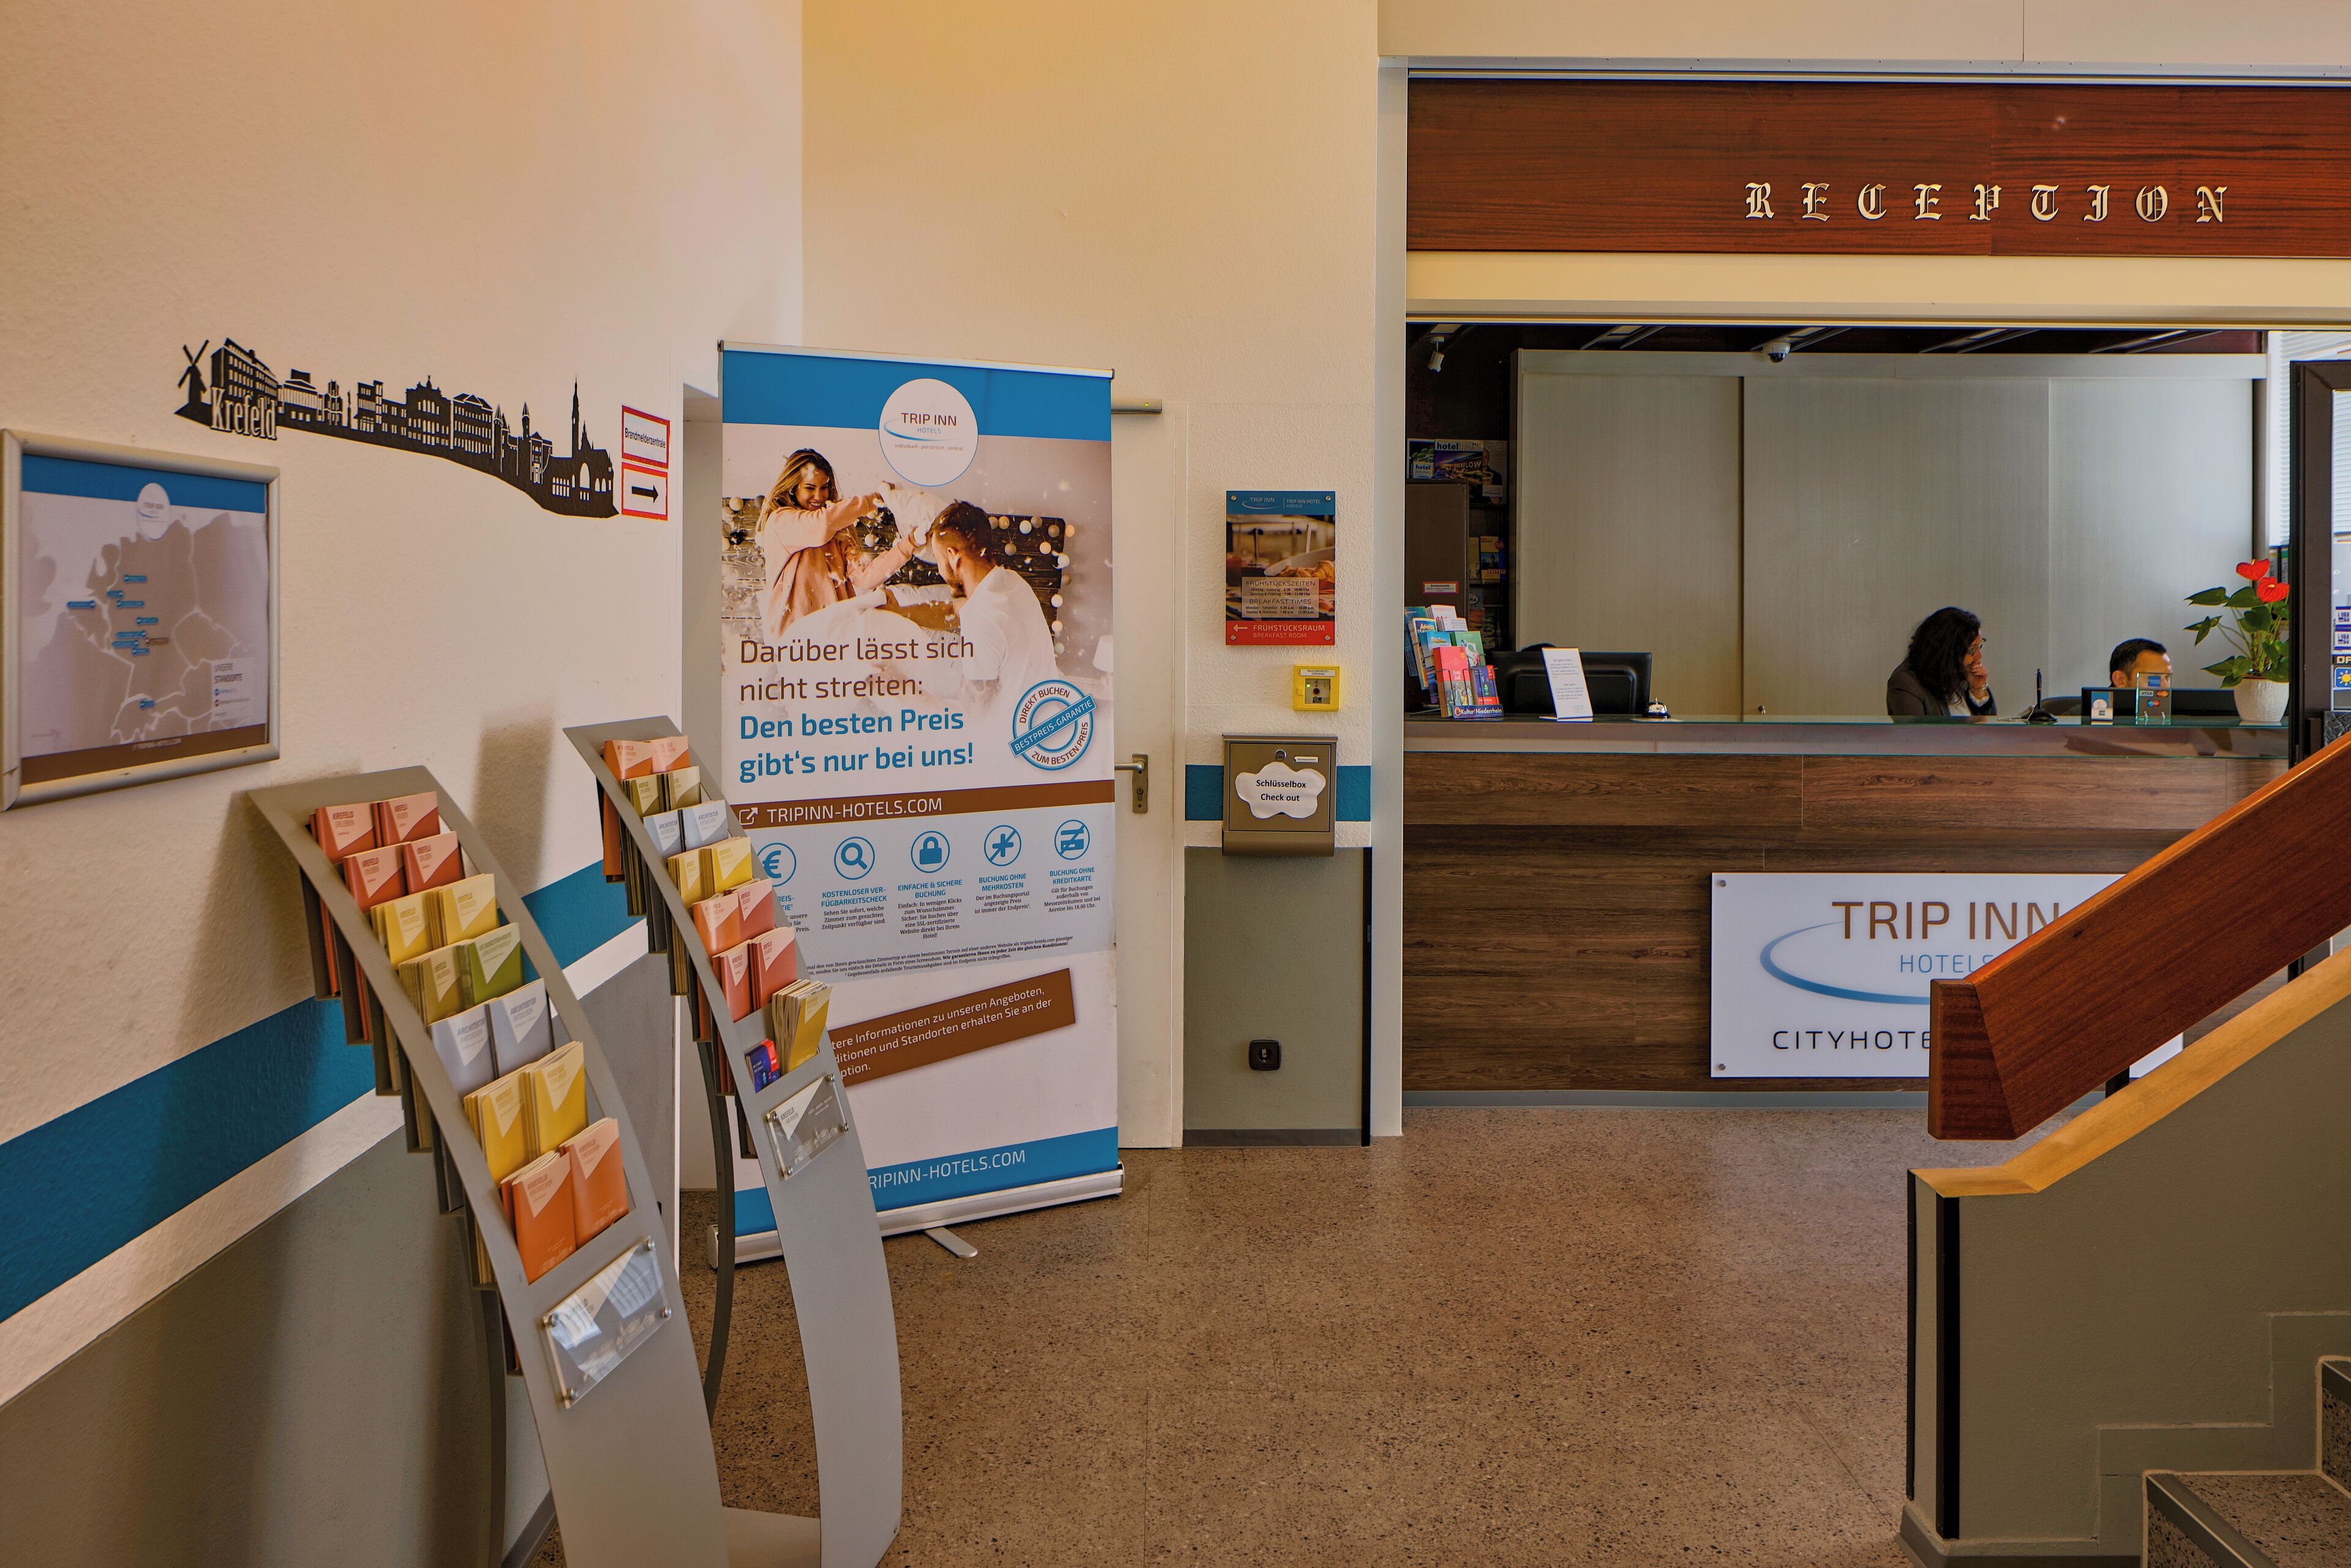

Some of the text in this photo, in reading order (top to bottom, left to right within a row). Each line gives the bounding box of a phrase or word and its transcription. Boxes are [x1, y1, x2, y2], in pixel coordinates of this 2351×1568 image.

[1745, 181, 2229, 224] RECEPTION
[211, 387, 277, 440] Krefeld
[901, 413, 956, 426] TRIP INN
[624, 427, 666, 449] Brandmelderzentrale
[1253, 623, 1325, 631] FRÜHSTÜCKSRAUM
[740, 636, 974, 664] Darüber lässt sich
[740, 674, 923, 702] nicht streiten:
[1019, 687, 1070, 724] DIREKT BUCHEN
[740, 707, 964, 740] Den besten Preis
[1014, 700, 1093, 752] BESTPREIS-GARANTIE
[1032, 722, 1089, 765] ZUM BESTEN PREIS
[824, 753, 869, 772] nur
[876, 745, 913, 769] bei
[921, 742, 973, 767] uns!
[1256, 779, 1307, 789] Schlüsselbox
[767, 798, 942, 823] TRIPINN-HOTELS.COM
[979, 875, 1008, 883] BUCHUNG
[982, 882, 1024, 891] MEHRKOSTEN
[1052, 876, 1092, 885] KREDITKARTE
[821, 895, 887, 907] FÜGBARKEITSCHECK
[822, 888, 869, 898] KOSTENLOSER
[915, 890, 946, 898] BUCHUNG
[993, 891, 1030, 899] Buchungsportal
[1044, 898, 1083, 907] Messezeiträumen
[1832, 901, 2060, 940] TRIP INN
[855, 1016, 931, 1043] Informationen
[932, 1011, 945, 1024] zu
[947, 1002, 988, 1020] unseren
[989, 986, 1045, 1010] Angeboten,
[879, 1038, 899, 1052] und
[901, 1022, 959, 1046] Standorten
[961, 1010, 1003, 1030] erhalten
[1005, 1006, 1020, 1019] Sie
[1022, 1003, 1035, 1015] an
[1036, 997, 1052, 1011] der
[841, 1061, 871, 1078] ption.
